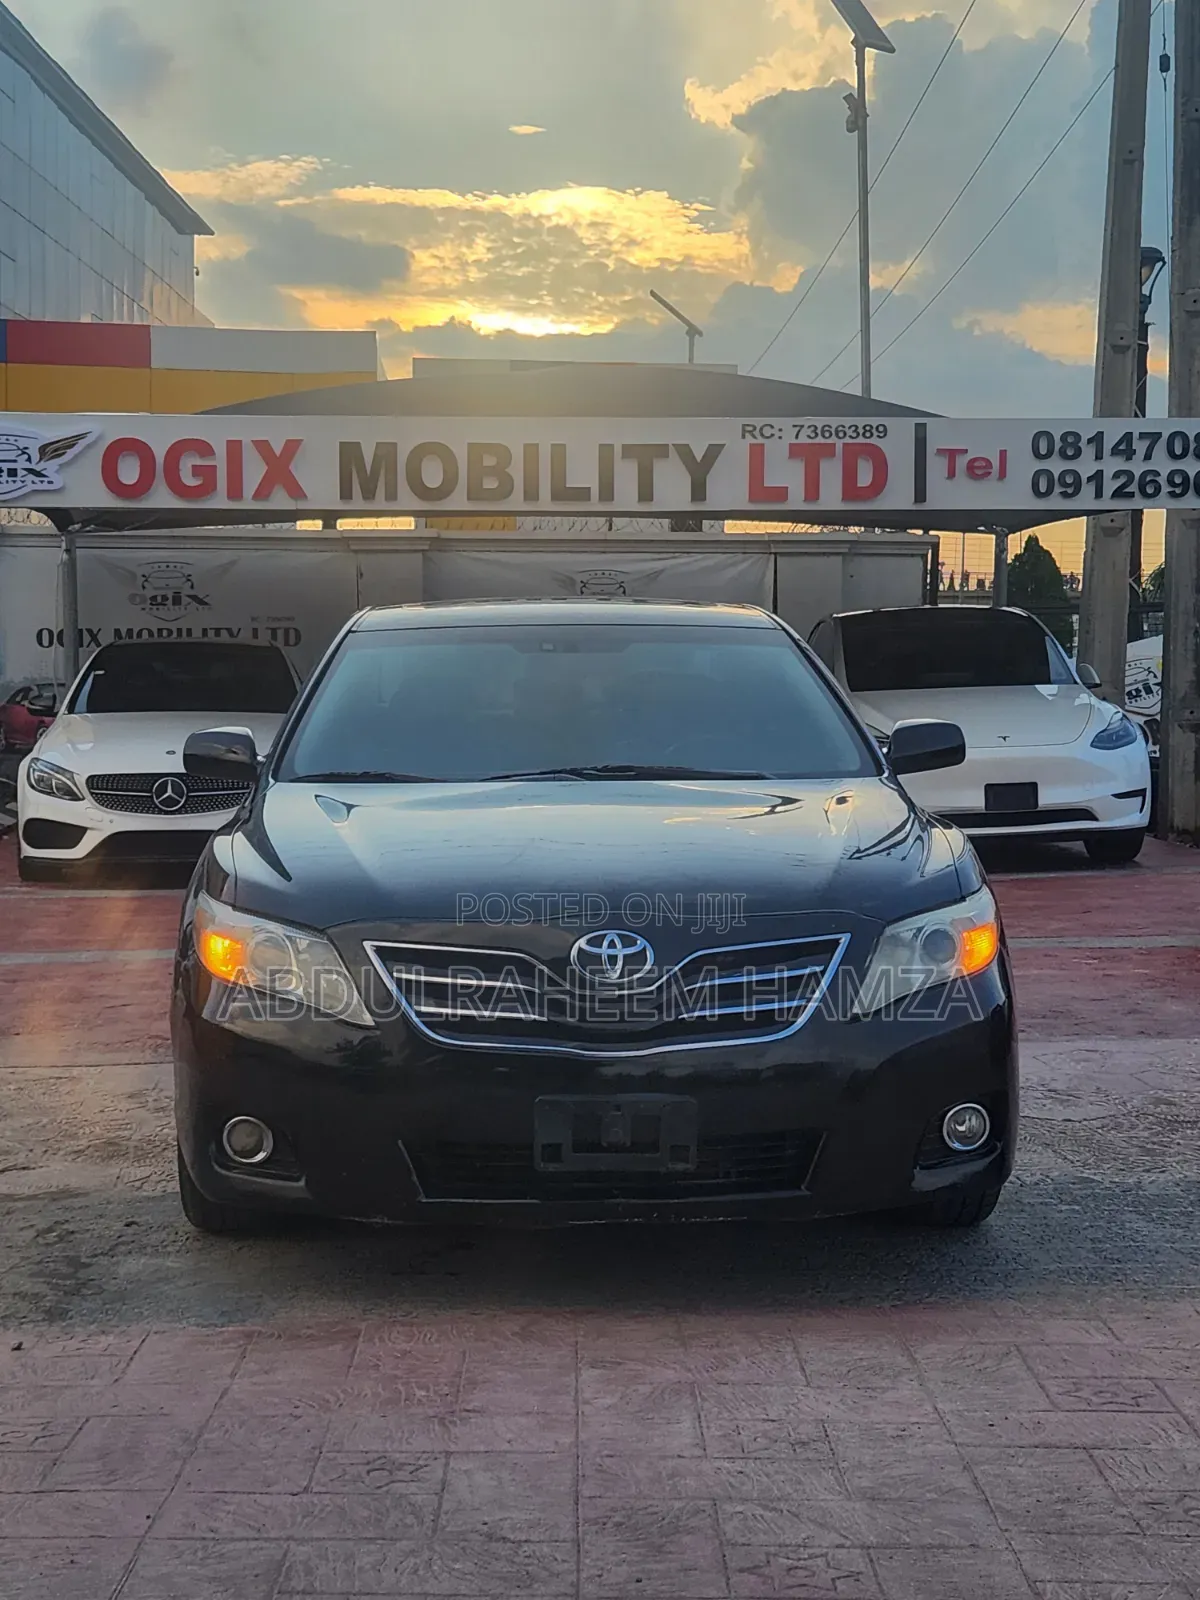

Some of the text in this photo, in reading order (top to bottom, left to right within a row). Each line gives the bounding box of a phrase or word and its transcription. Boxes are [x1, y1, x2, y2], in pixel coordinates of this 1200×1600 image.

[741, 423, 888, 440] RC: 7366389
[101, 437, 889, 503] OGIX MOBILITY LTD
[935, 448, 1008, 481] Tel
